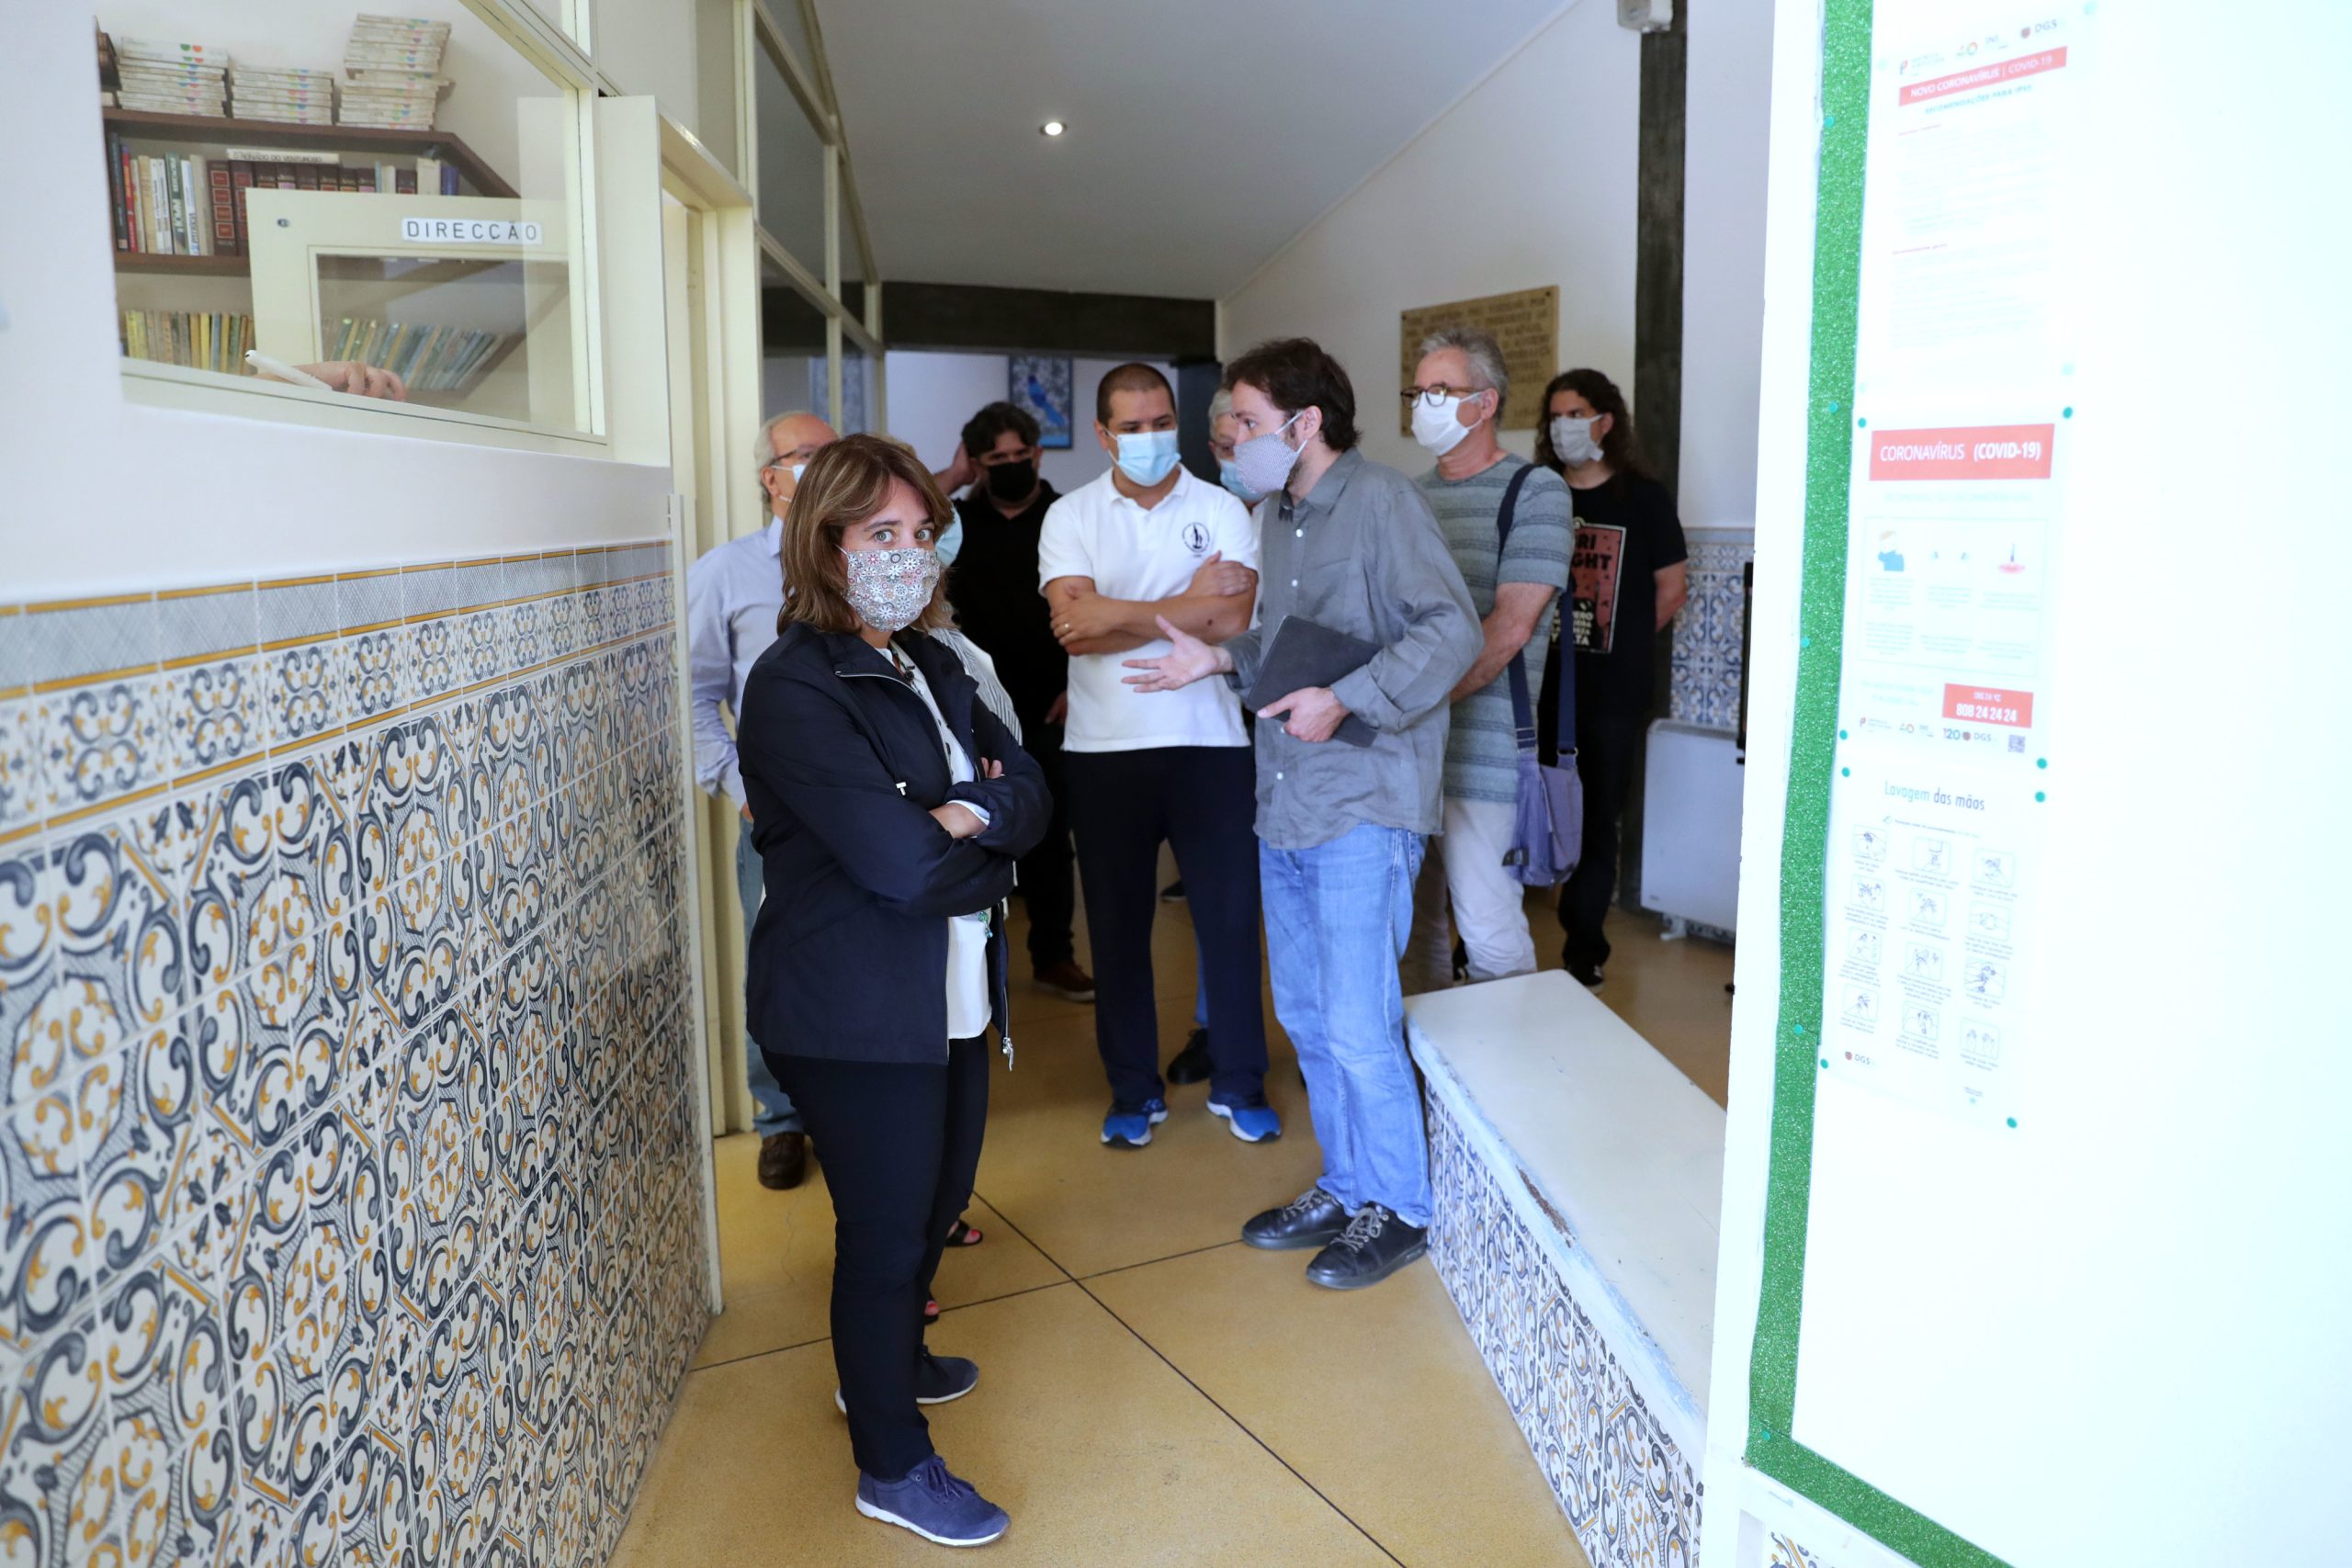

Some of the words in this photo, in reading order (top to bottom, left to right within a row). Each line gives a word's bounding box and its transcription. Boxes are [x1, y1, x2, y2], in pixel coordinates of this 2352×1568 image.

[2034, 19, 2058, 33] DGS
[1910, 84, 1935, 97] NOVO
[1936, 68, 2001, 92] CORONAVÍRUS
[2007, 55, 2052, 74] COVID-19
[1880, 440, 1965, 462] CORONAVÍRUS
[1973, 441, 2042, 463] (COVID-19)
[1956, 704, 1974, 717] 808
[1975, 705, 1988, 719] 24
[1990, 707, 2002, 720] 24
[2004, 708, 2017, 723] 24
[1973, 731, 1992, 742] DGS
[1884, 781, 1930, 804] Lavagem
[1933, 787, 1952, 807] das
[1955, 794, 1985, 812] mãos
[1854, 1054, 1871, 1066] DGS
